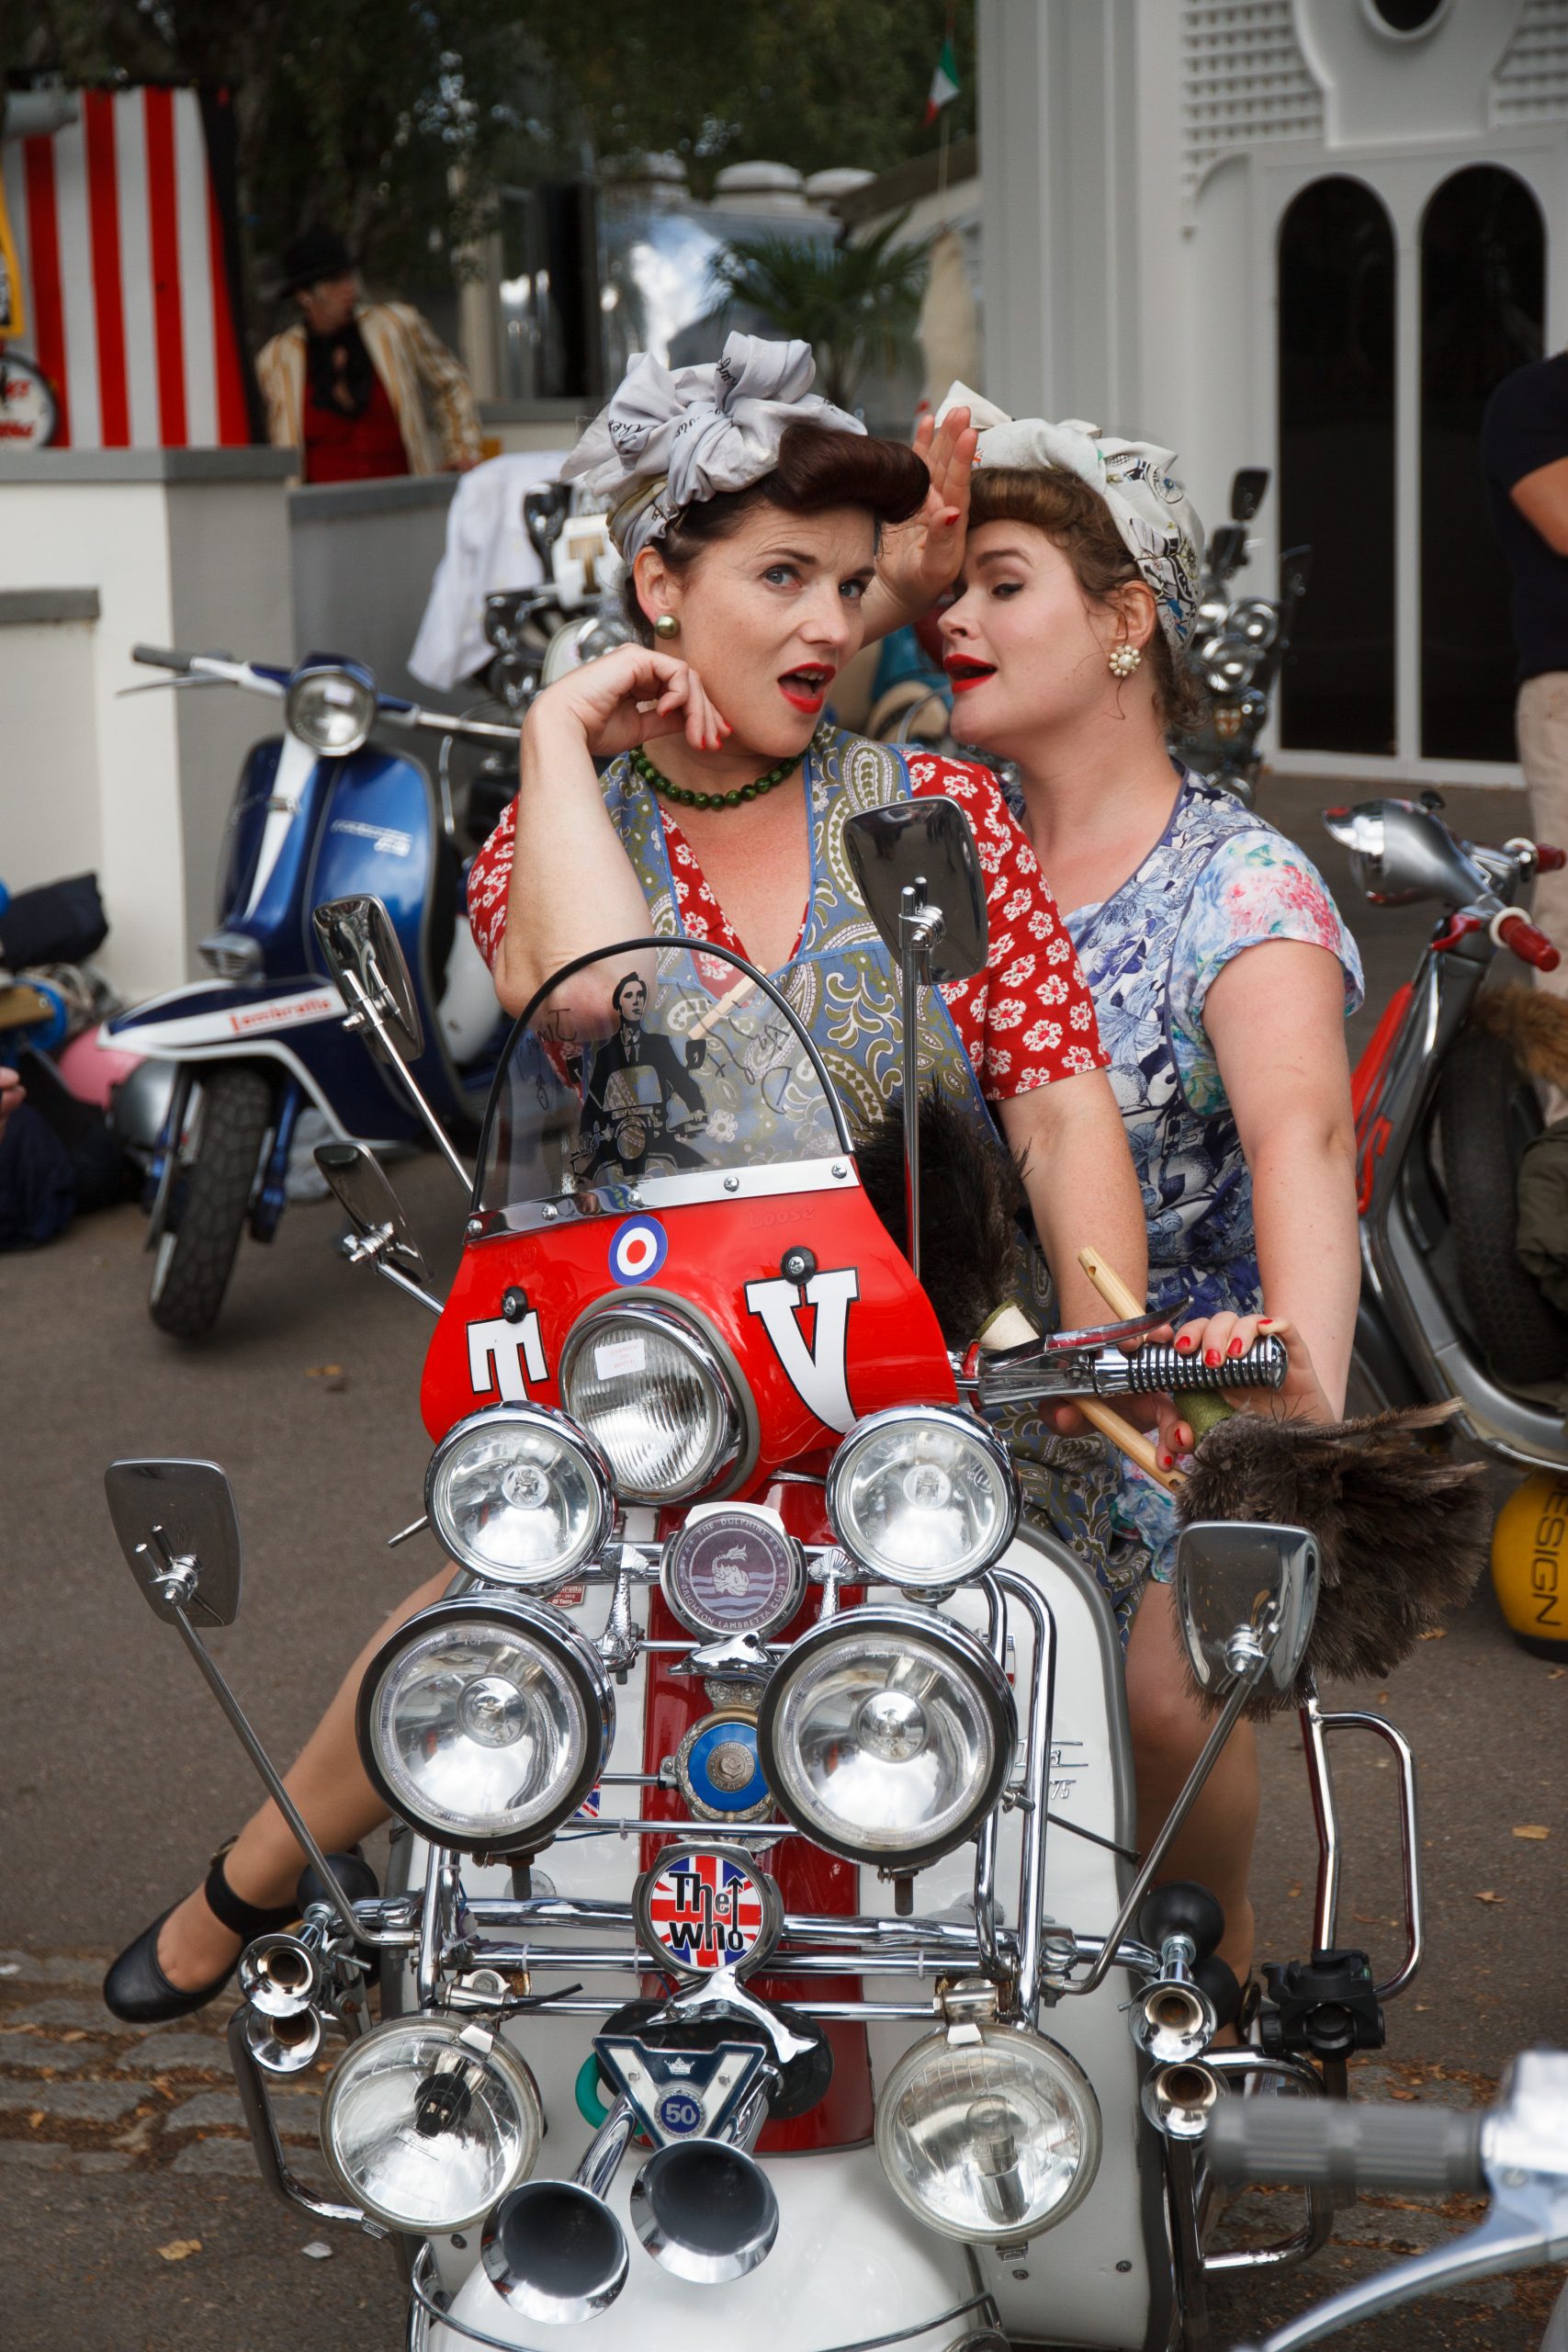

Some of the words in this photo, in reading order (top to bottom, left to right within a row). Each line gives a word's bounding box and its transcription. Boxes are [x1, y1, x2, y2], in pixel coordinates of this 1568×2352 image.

[696, 1521, 715, 1536] THE
[720, 1517, 767, 1536] DOLPHINS
[1531, 1477, 1568, 1626] ESIGN
[681, 1584, 715, 1625] BRIGHTON
[717, 1610, 772, 1630] LAMBRETTA
[771, 1584, 786, 1609] CLUB
[668, 1871, 730, 1915] The
[665, 2103, 697, 2125] 50
